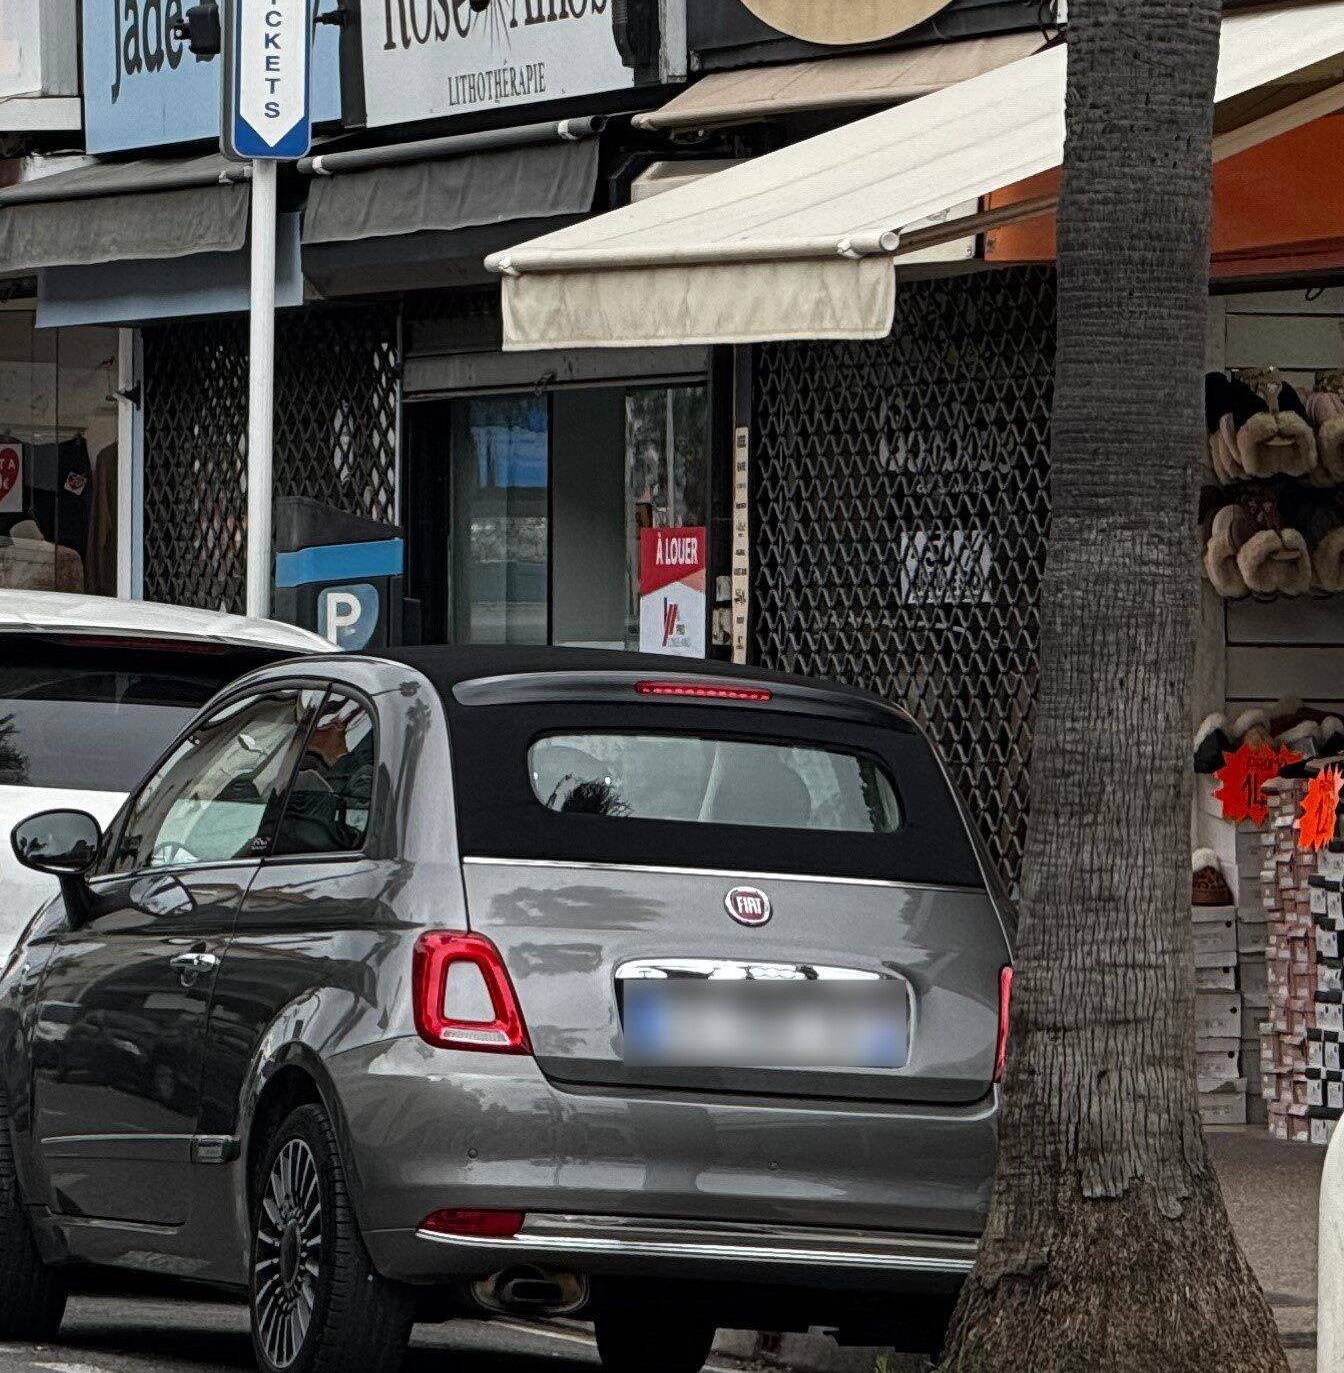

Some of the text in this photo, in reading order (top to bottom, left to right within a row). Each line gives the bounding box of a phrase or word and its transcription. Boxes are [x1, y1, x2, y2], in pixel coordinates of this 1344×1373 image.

[665, 537, 698, 565] LOUER
[327, 593, 362, 646] P
[736, 896, 762, 914] FIAT
